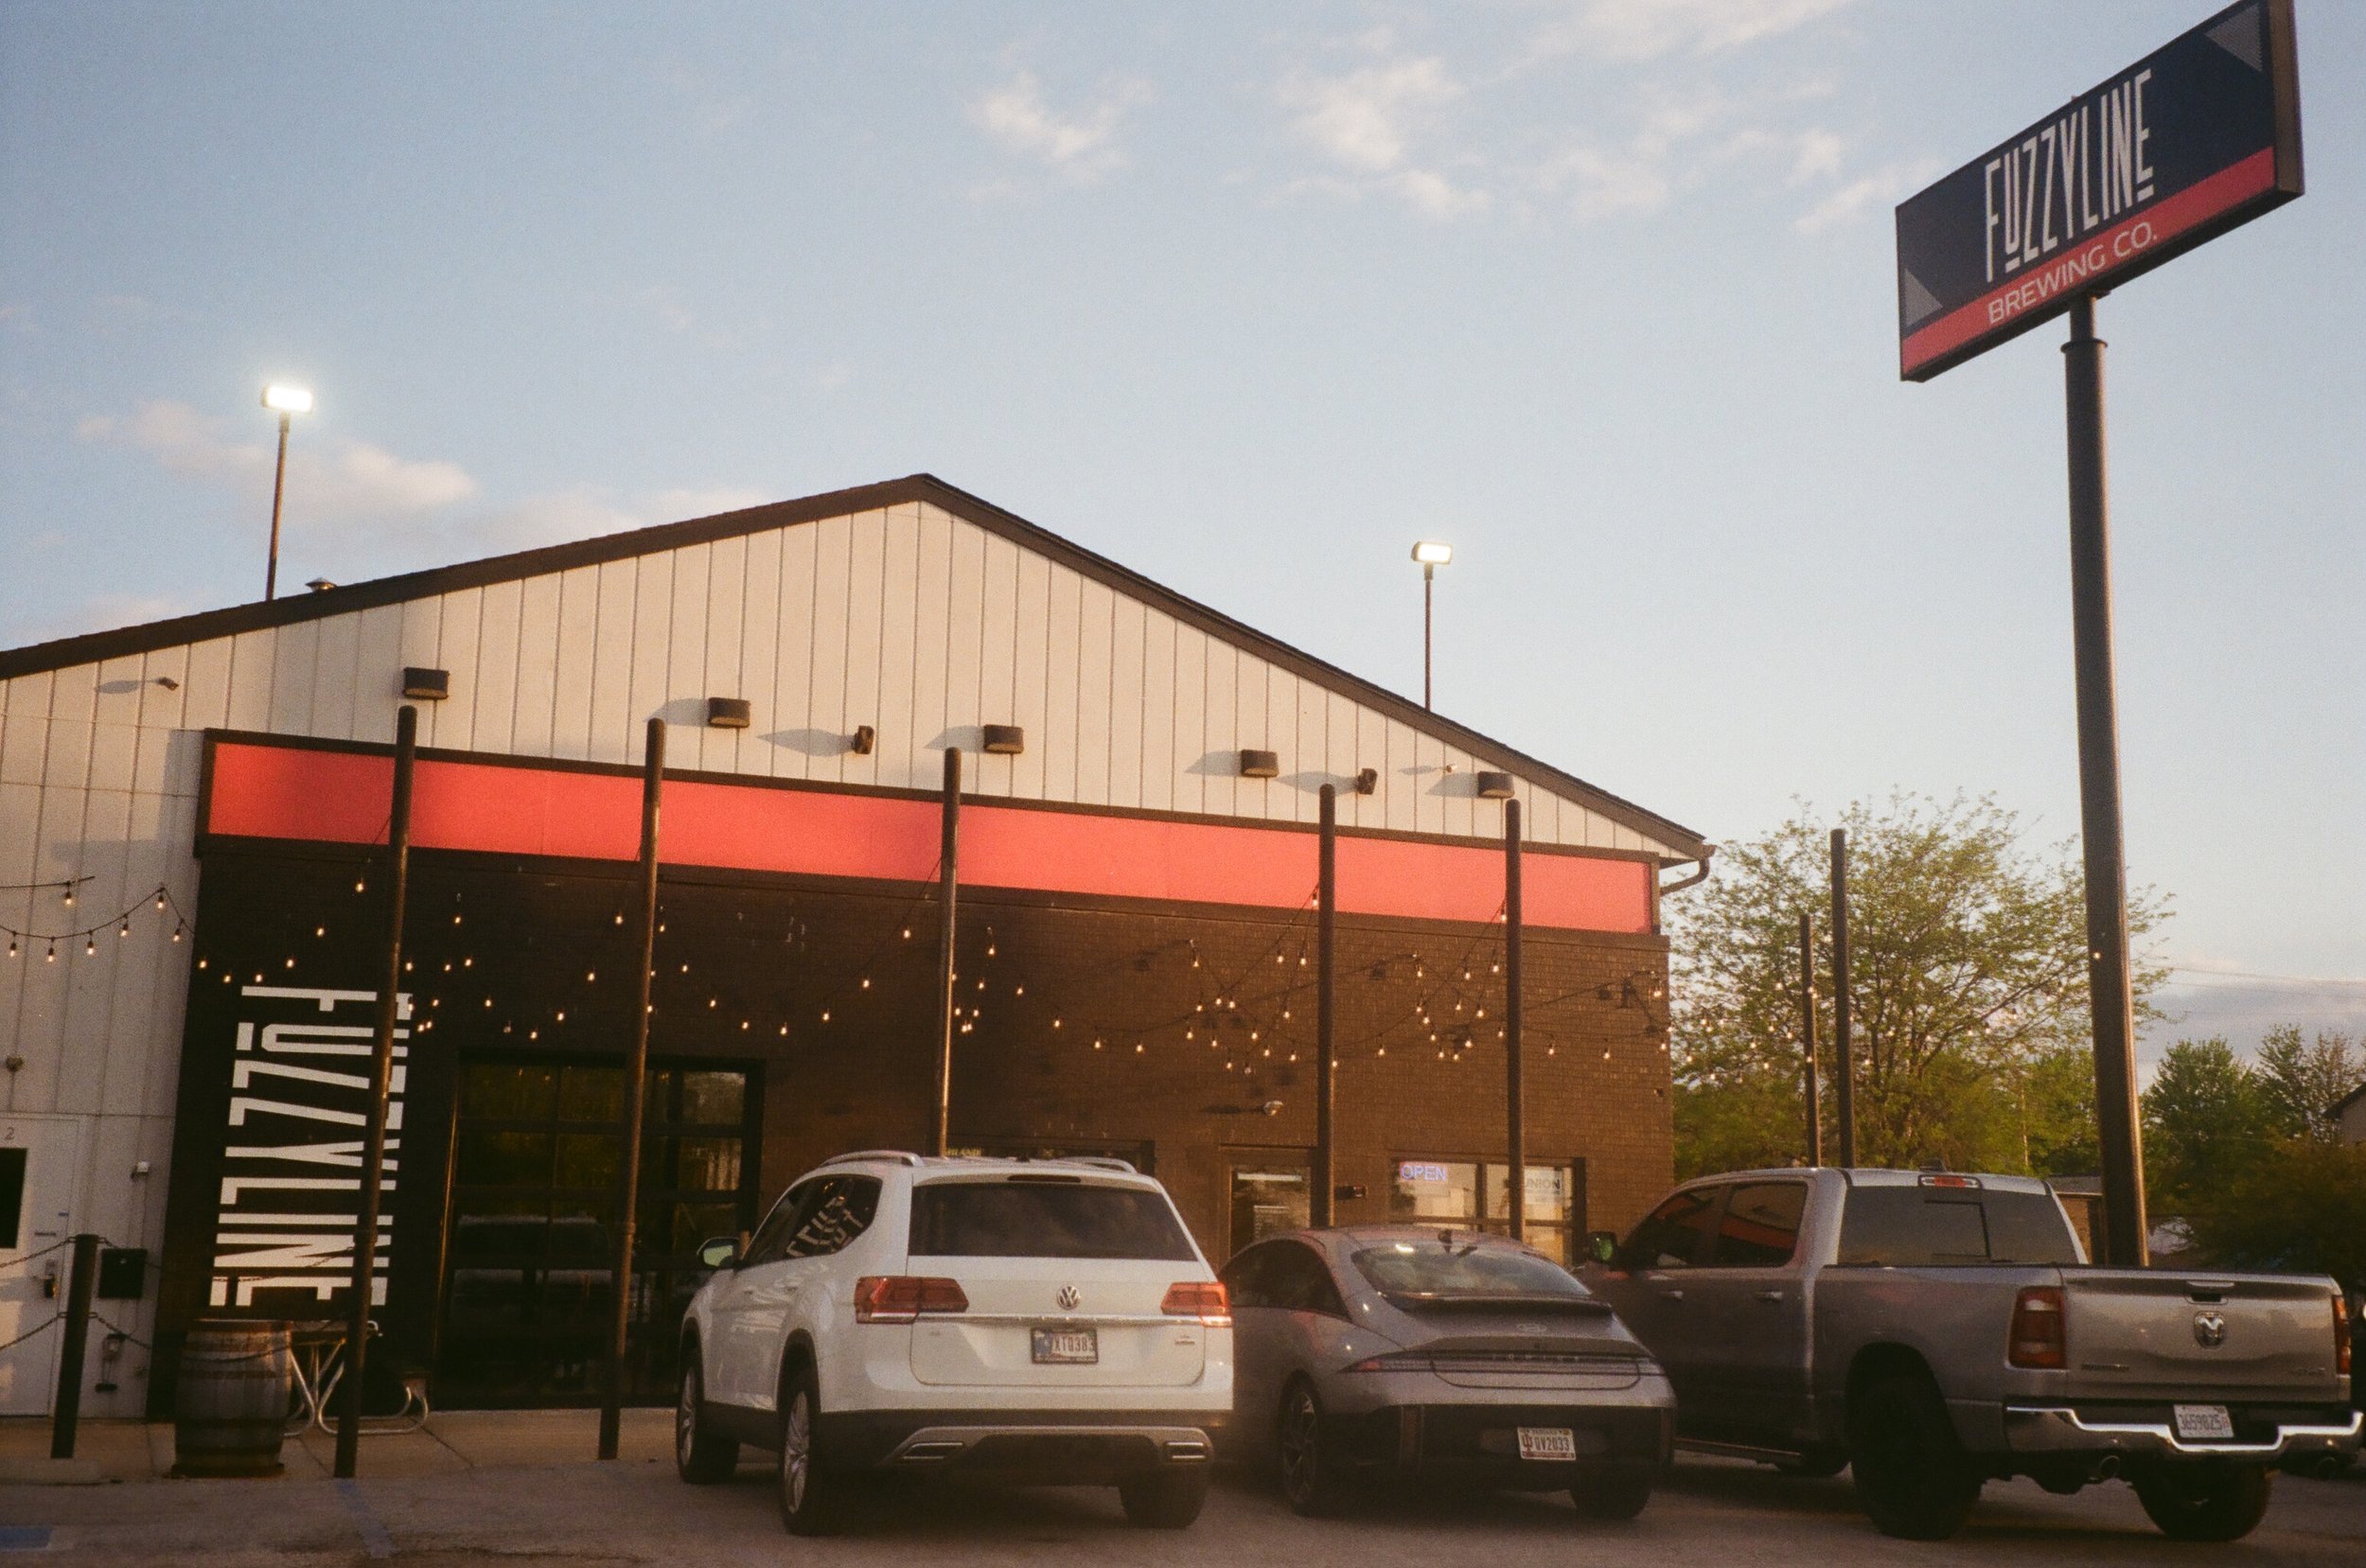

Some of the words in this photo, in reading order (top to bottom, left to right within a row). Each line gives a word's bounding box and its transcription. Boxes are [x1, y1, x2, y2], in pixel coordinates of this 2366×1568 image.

[1985, 68, 2154, 283] FUZZYLINE
[1987, 244, 2106, 325] BREWING
[2112, 221, 2158, 258] CO.
[209, 985, 413, 1307] FUZZYLINE
[1401, 1165, 1447, 1182] OPEN
